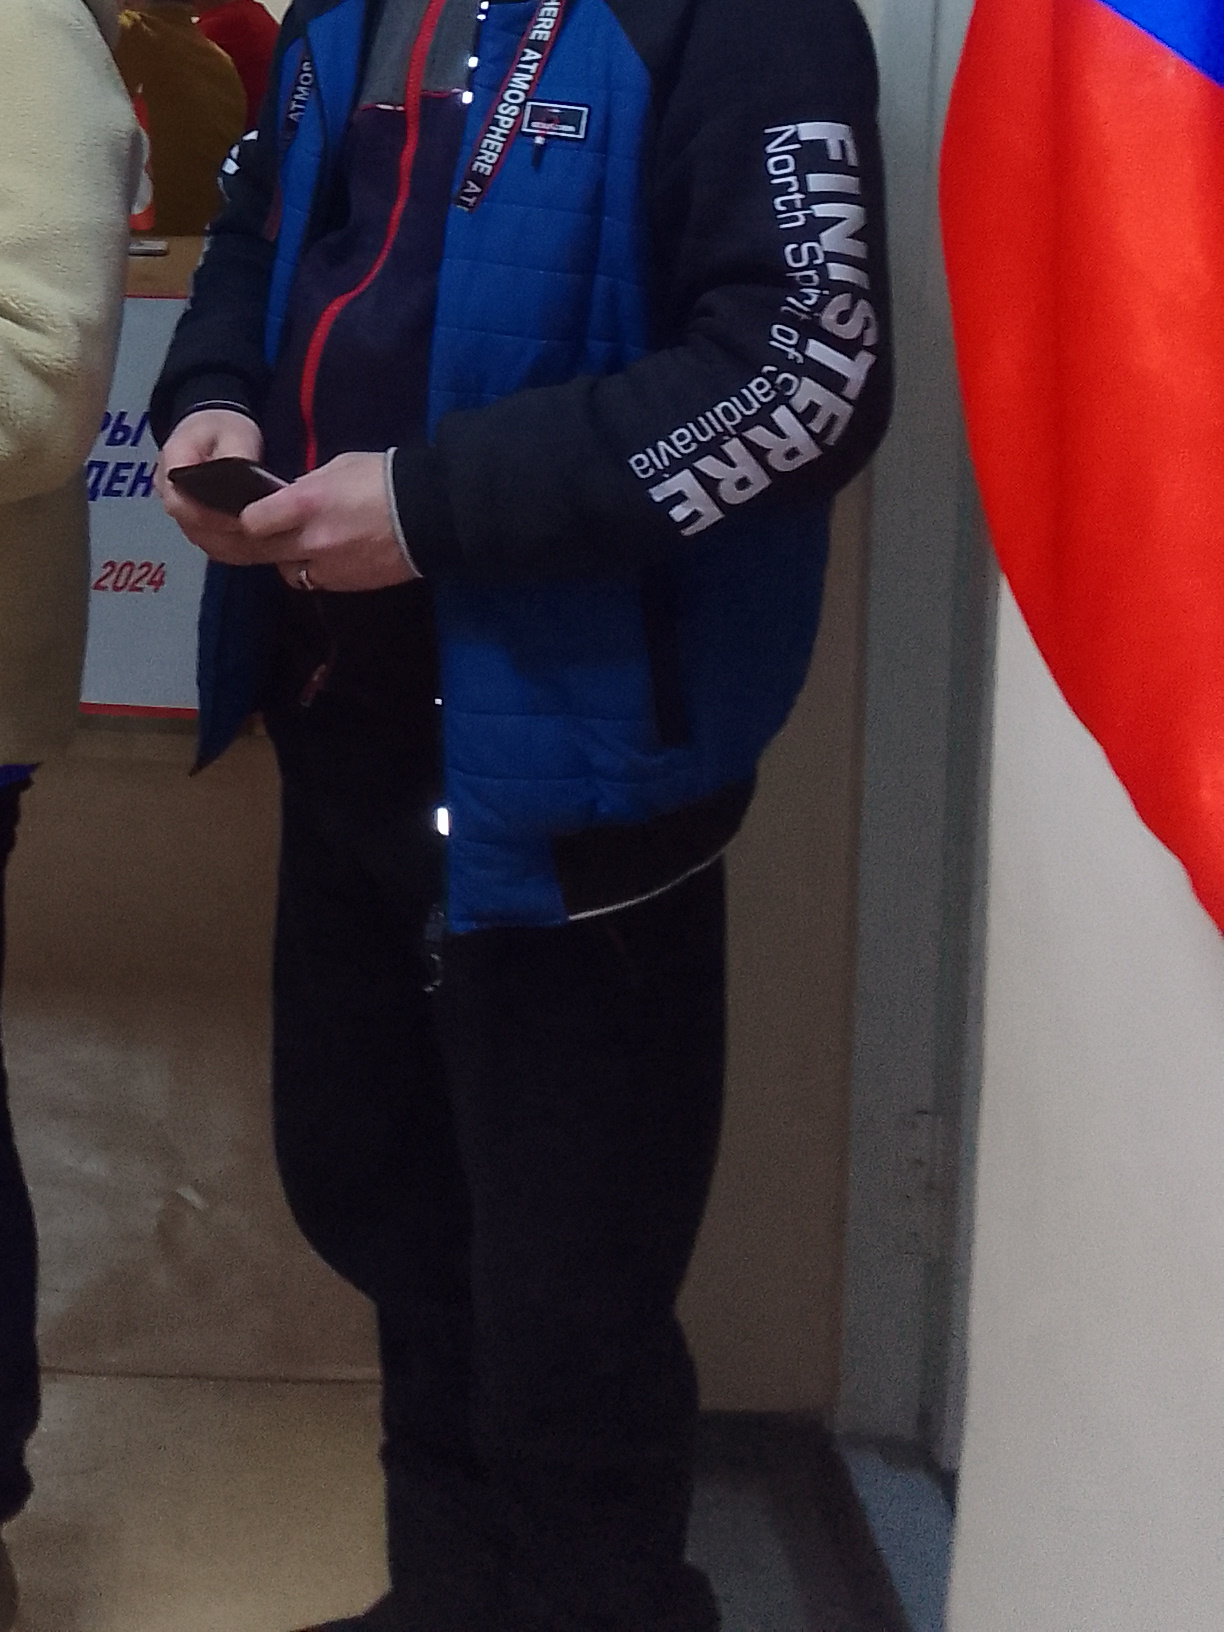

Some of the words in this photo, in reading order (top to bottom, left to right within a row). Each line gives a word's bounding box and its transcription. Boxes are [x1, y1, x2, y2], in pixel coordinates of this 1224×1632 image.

[471, 48, 543, 177] ATMOSPHERE
[456, 180, 483, 212] AT
[763, 124, 815, 230] North
[648, 121, 877, 536] FINISTERRE
[769, 324, 804, 365] of
[627, 365, 800, 479] Sandinavia
[93, 560, 165, 593] 2024
